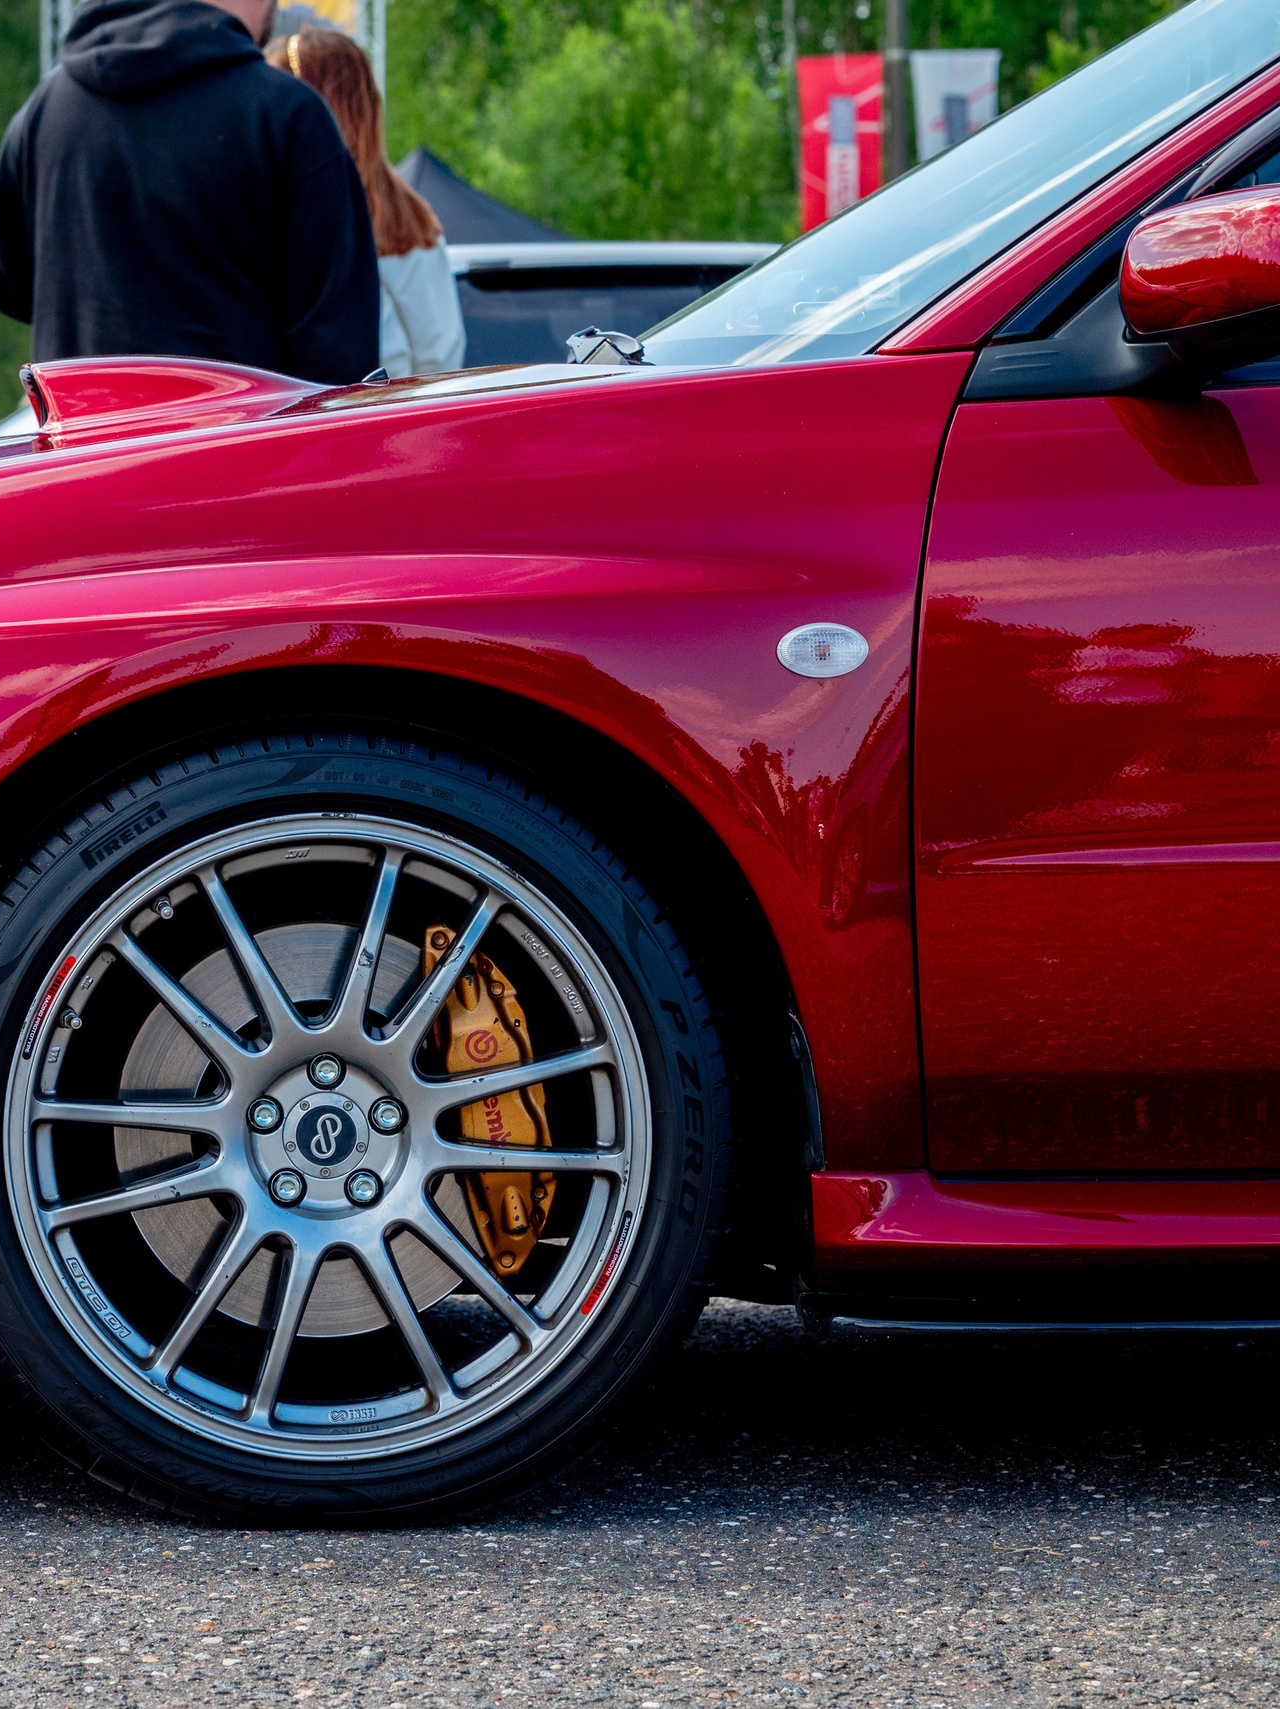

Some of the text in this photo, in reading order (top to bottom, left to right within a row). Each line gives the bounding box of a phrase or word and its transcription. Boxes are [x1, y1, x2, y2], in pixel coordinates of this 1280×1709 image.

[79, 801, 168, 871] PIRELLI
[521, 930, 550, 960] JAPAN
[38, 994, 52, 1018] RACING
[563, 984, 584, 1015] MADE
[24, 1016, 42, 1053] PROTOTYPE
[658, 998, 706, 1229] P ZERO
[605, 1255, 618, 1276] RACING
[617, 1217, 631, 1254] PROTOTYPE
